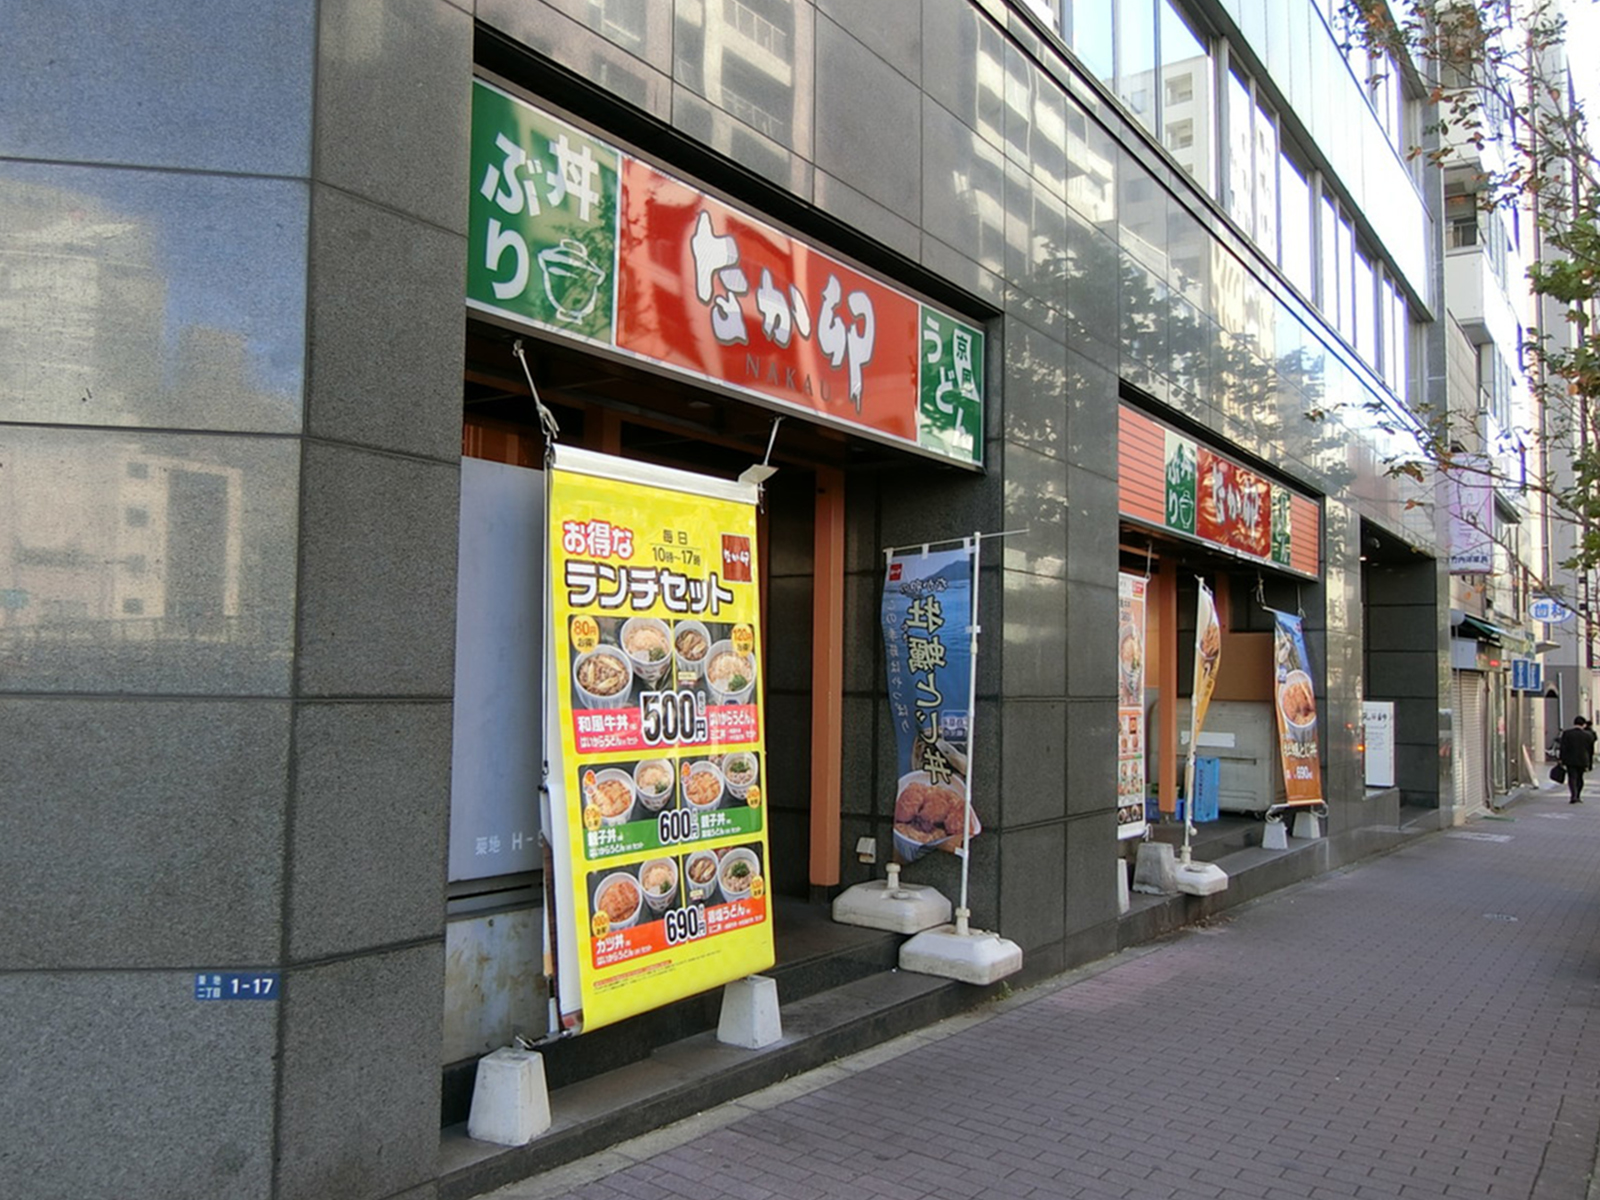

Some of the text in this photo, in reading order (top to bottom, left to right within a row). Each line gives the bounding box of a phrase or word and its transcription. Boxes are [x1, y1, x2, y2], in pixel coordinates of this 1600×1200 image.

[546, 133, 600, 222] 丼
[480, 132, 544, 300] ぶり
[690, 209, 876, 415] なか卯
[745, 353, 830, 401] NAKAU
[563, 519, 633, 559] お得な
[663, 529, 688, 546] 毎日
[723, 548, 750, 567] なか卯
[565, 559, 733, 615] ランチセット
[573, 620, 597, 636] 80円
[1534, 603, 1567, 618] 歯科
[640, 690, 707, 745] 500円
[231, 978, 273, 994] 1-17
